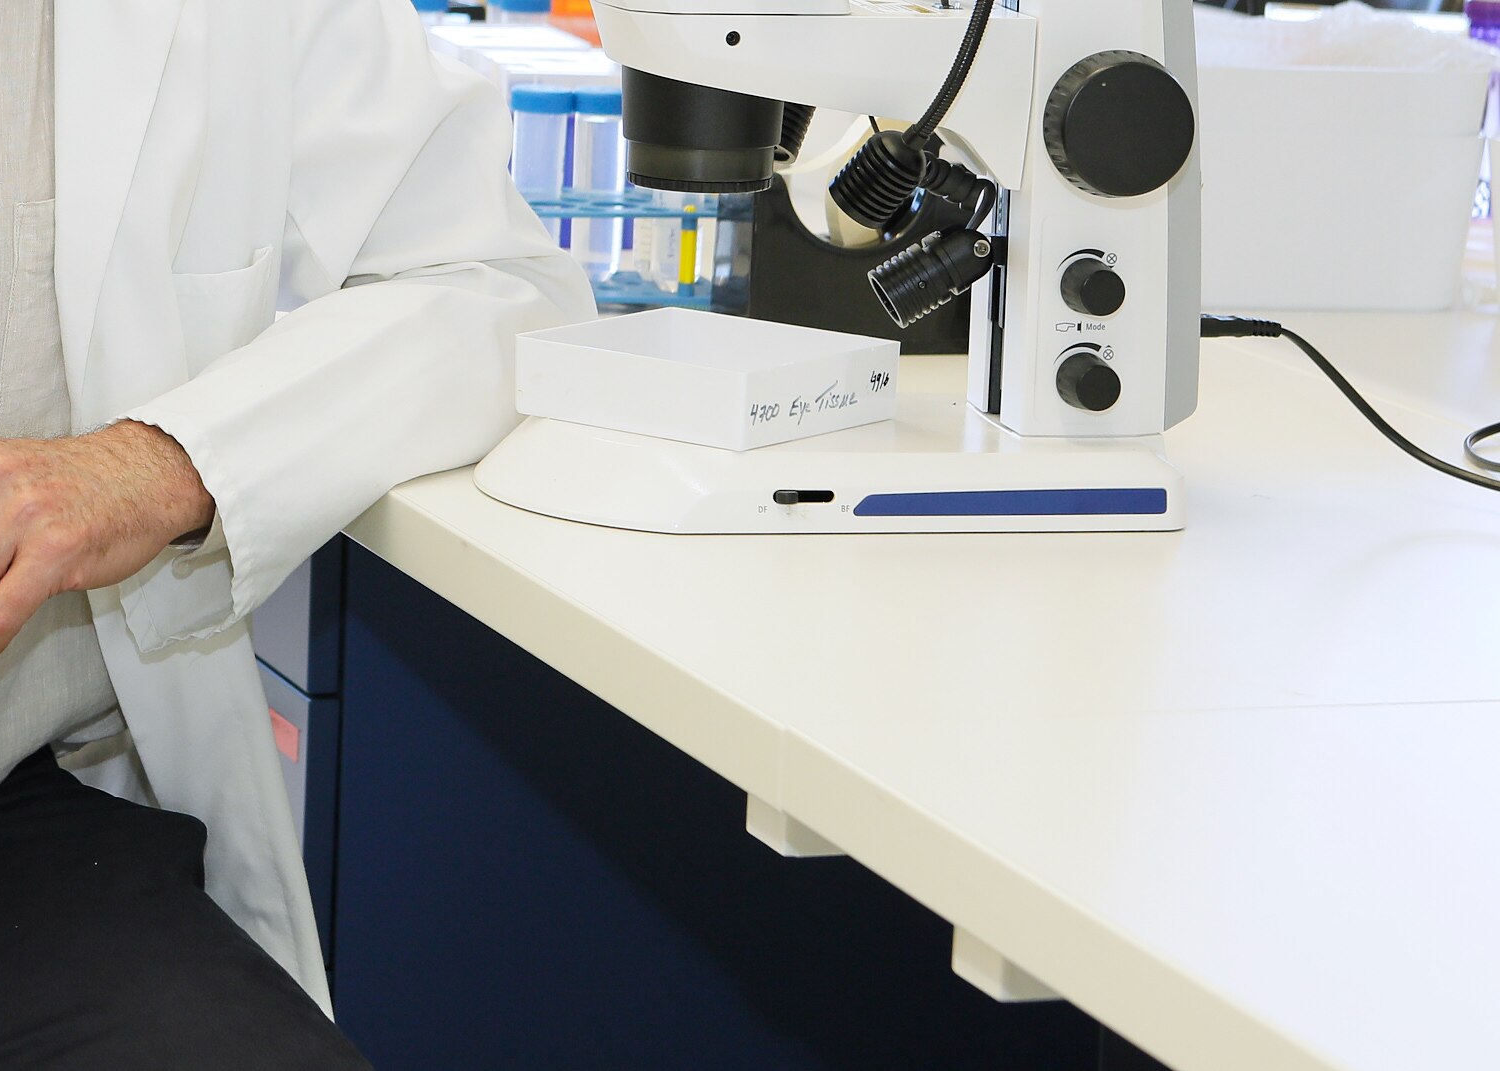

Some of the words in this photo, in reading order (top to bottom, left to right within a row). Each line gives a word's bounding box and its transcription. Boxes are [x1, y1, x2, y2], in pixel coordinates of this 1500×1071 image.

[1085, 322, 1106, 331] Mode
[750, 402, 780, 426] 4700
[788, 395, 811, 425] Eye
[814, 379, 859, 413] Tissue
[758, 505, 768, 513] DF
[841, 505, 850, 513] BF
